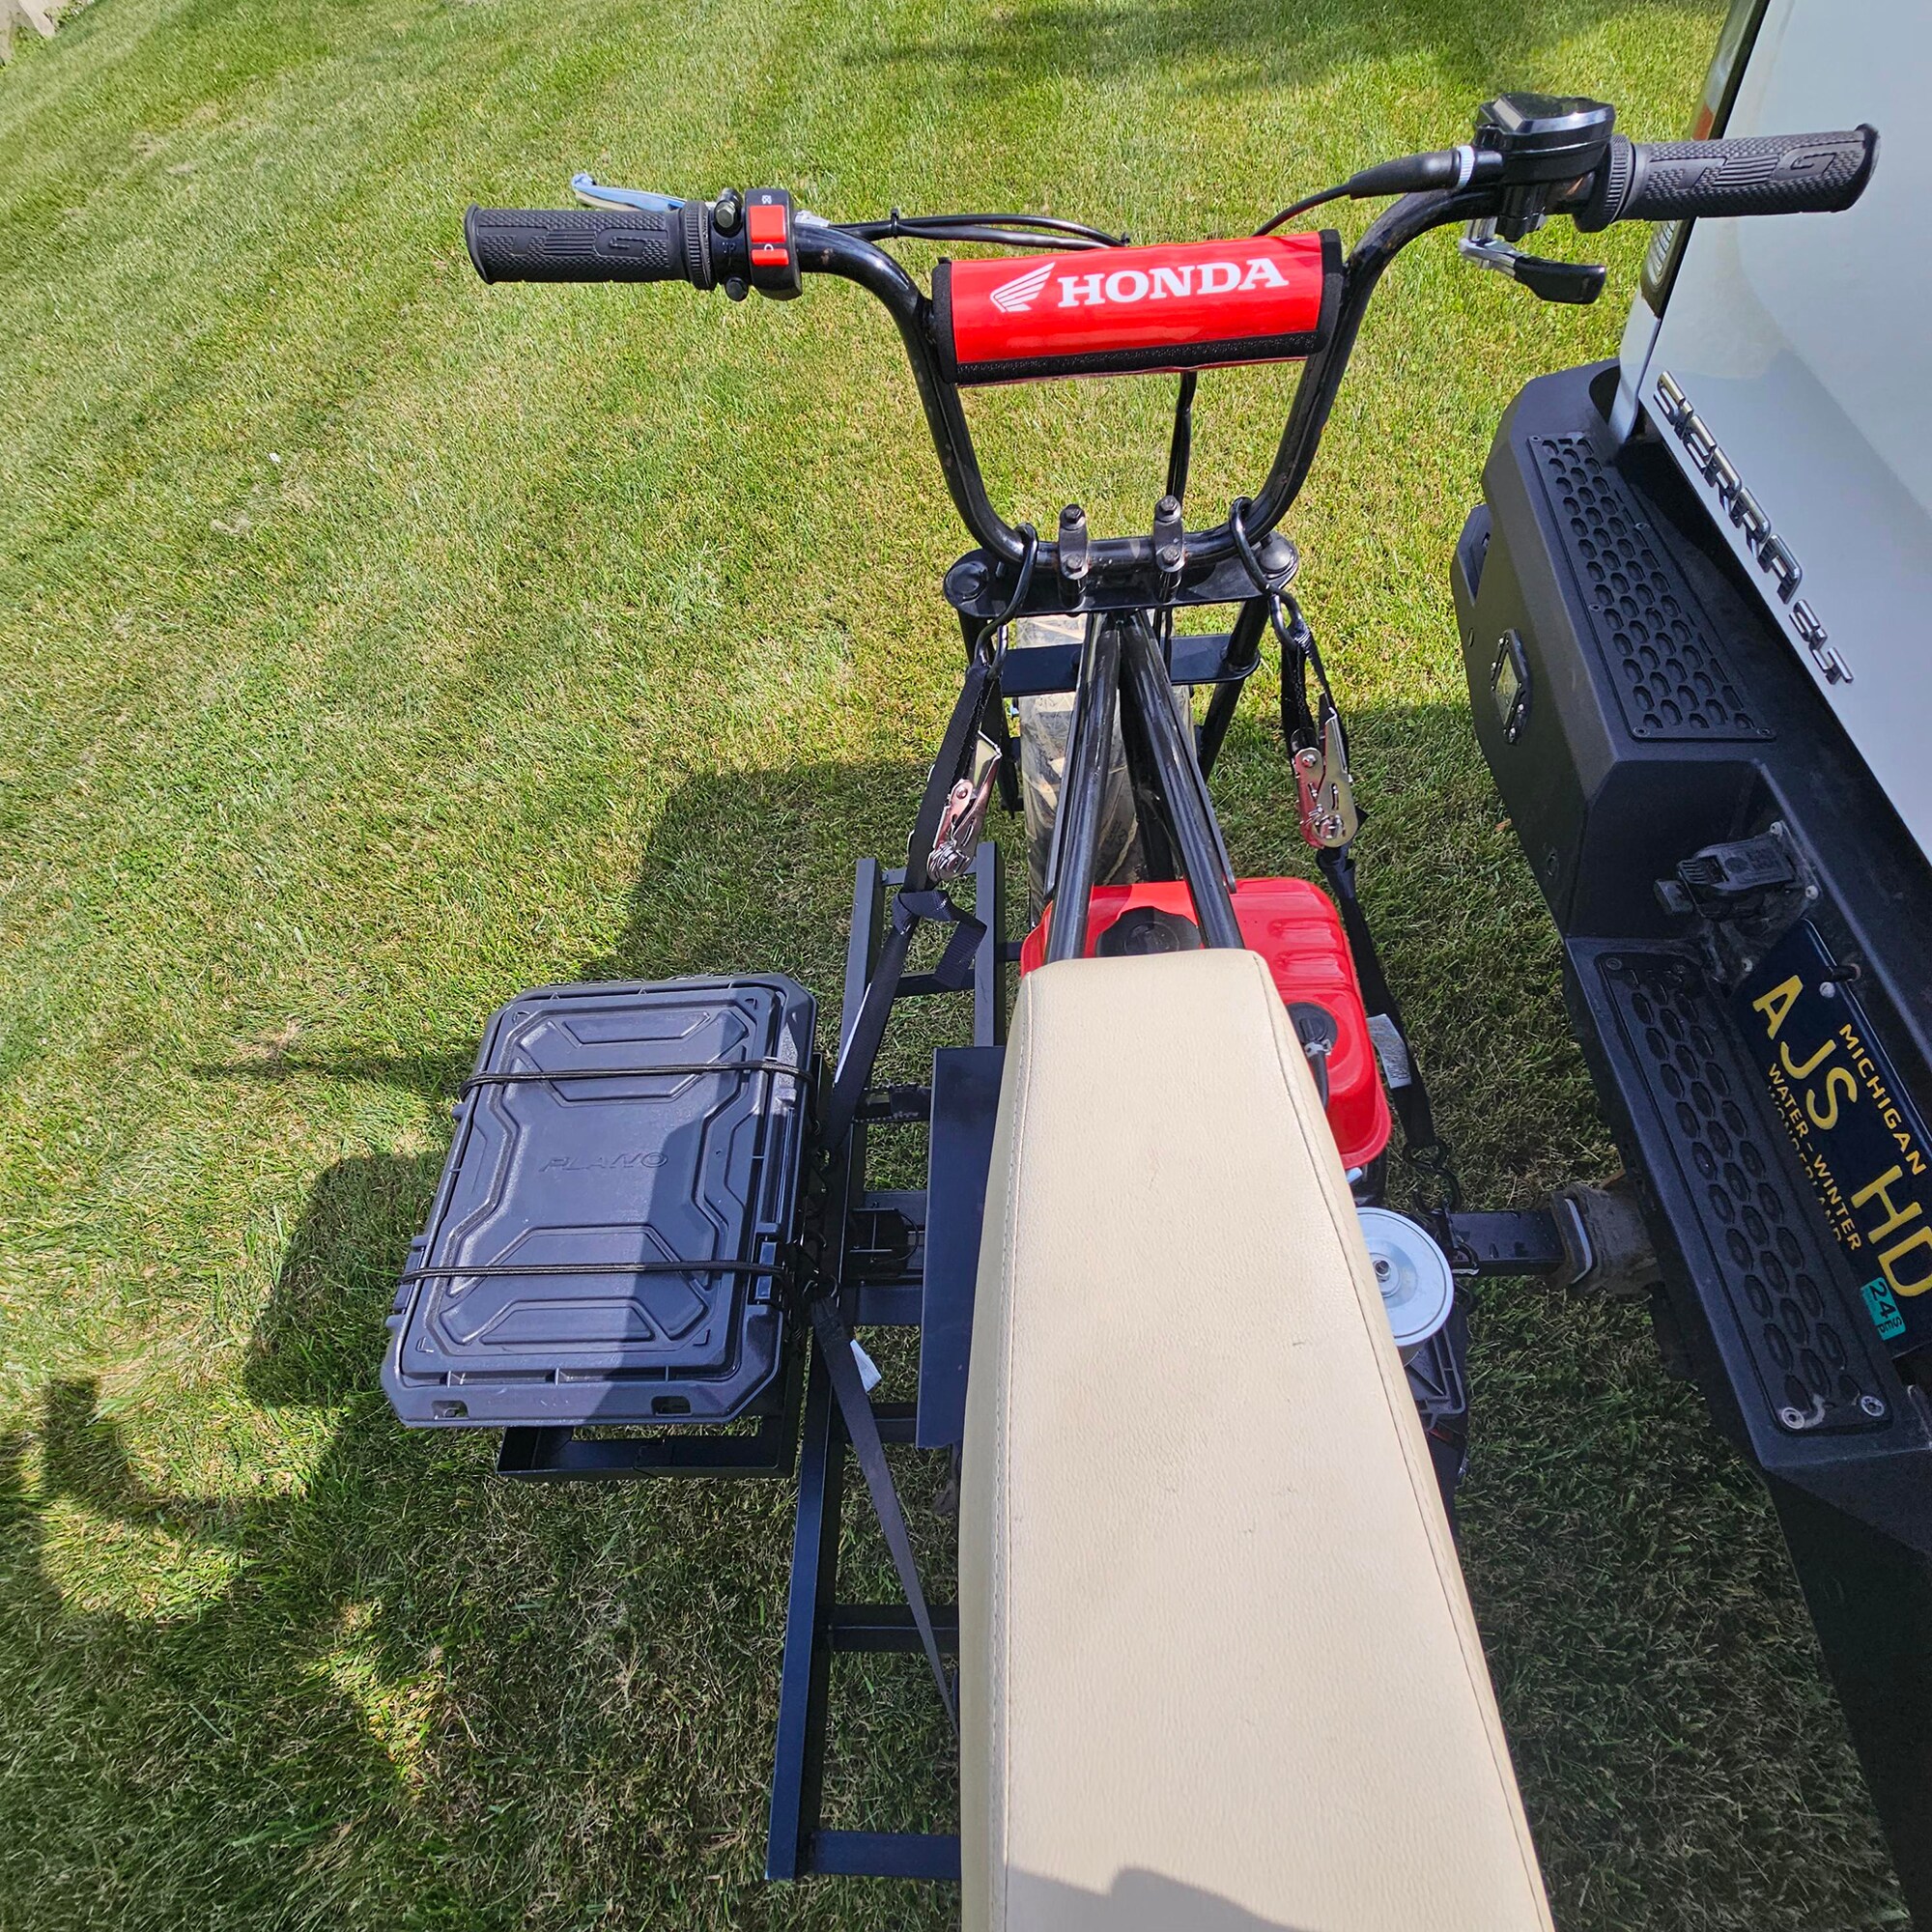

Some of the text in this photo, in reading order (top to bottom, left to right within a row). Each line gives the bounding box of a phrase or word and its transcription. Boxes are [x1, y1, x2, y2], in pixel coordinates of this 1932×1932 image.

[1057, 257, 1290, 308] HONDA
[1653, 370, 1855, 686] SIERRA SLT
[538, 1151, 668, 1173] PLANO
[1751, 974, 1859, 1130] AJS
[1851, 1164, 1932, 1297] HD
[1768, 1063, 1809, 1138] WATER
[1813, 1154, 1862, 1251] WINTER
[1838, 1023, 1928, 1177] MICHIGAN
[1869, 1281, 1896, 1319] 24
